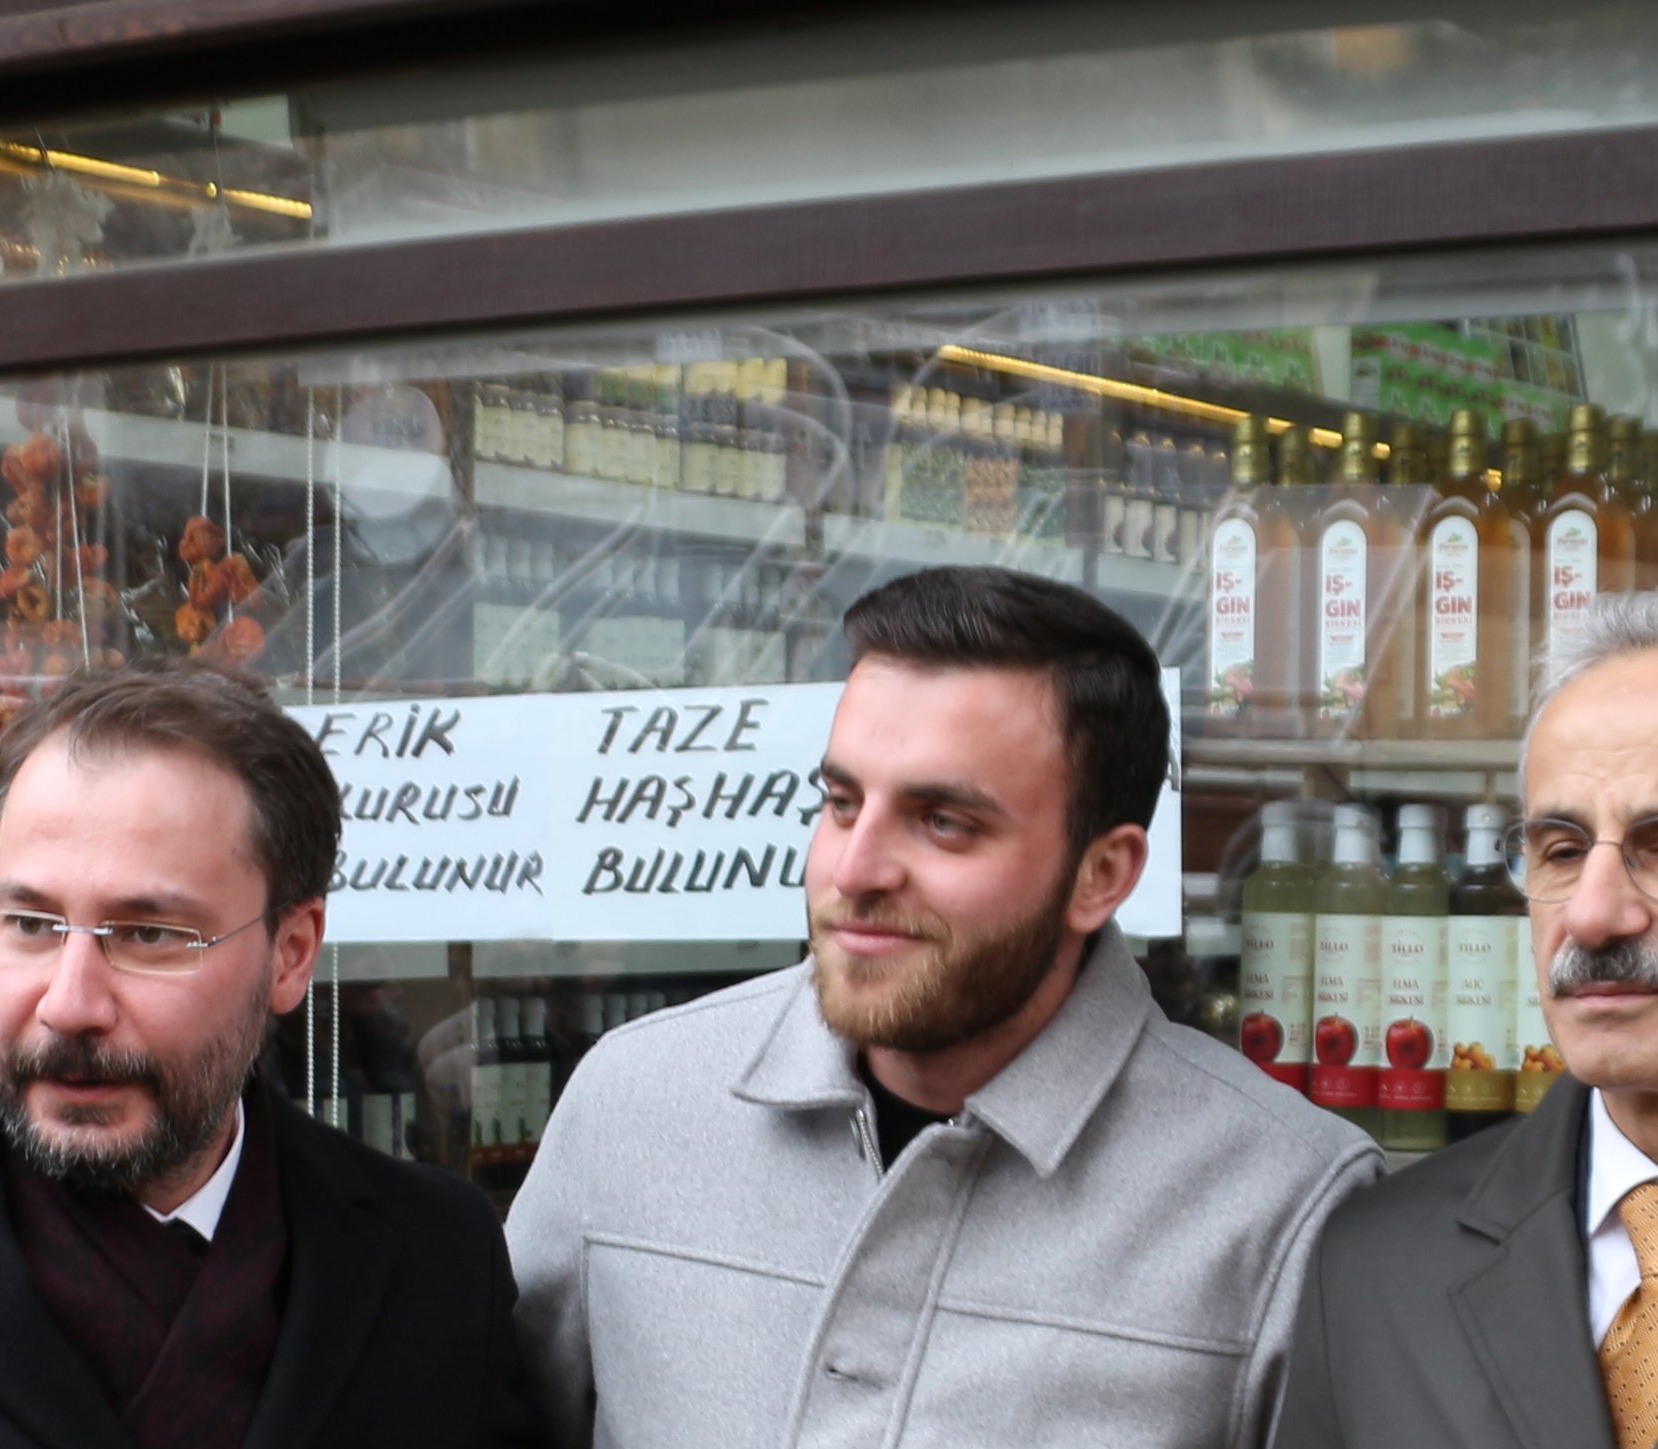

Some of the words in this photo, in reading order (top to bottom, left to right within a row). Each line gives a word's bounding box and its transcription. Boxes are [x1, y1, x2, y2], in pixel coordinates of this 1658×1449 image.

[315, 703, 461, 759] ERİK
[597, 698, 770, 755] TAZE
[575, 766, 829, 829] HAŞHAŞ
[581, 842, 806, 896] BULUNU
